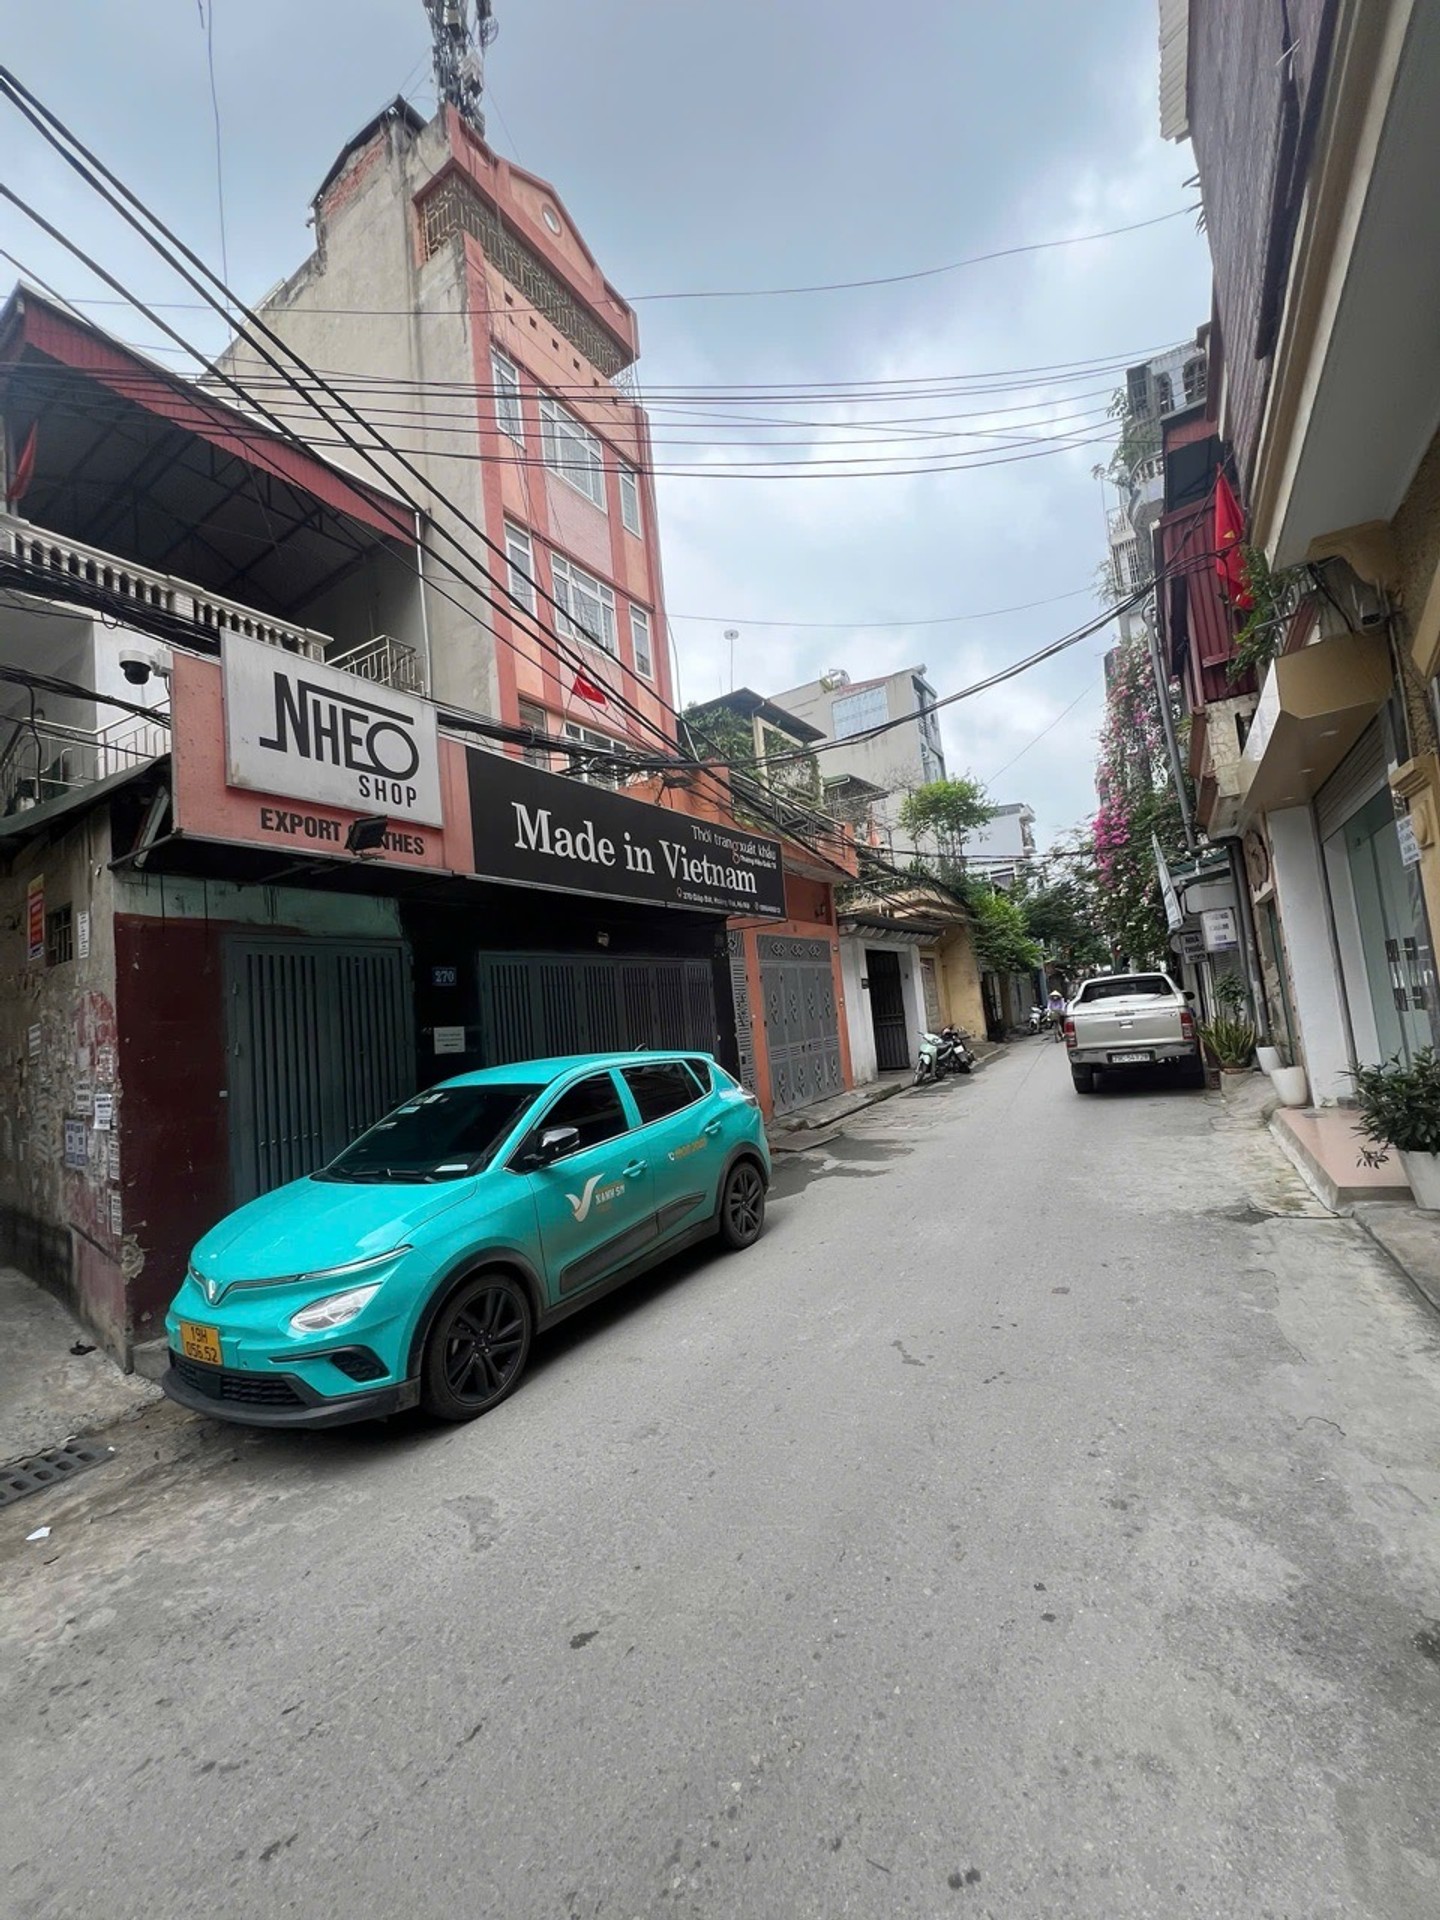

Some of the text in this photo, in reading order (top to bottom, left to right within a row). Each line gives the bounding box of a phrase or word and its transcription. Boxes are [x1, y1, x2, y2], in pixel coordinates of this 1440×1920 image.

[259, 671, 420, 781] NHEO
[358, 775, 417, 808] SHOP
[260, 807, 341, 842] EXPORT
[511, 801, 758, 895] Made in Vietnam
[190, 1326, 208, 1345] 19H
